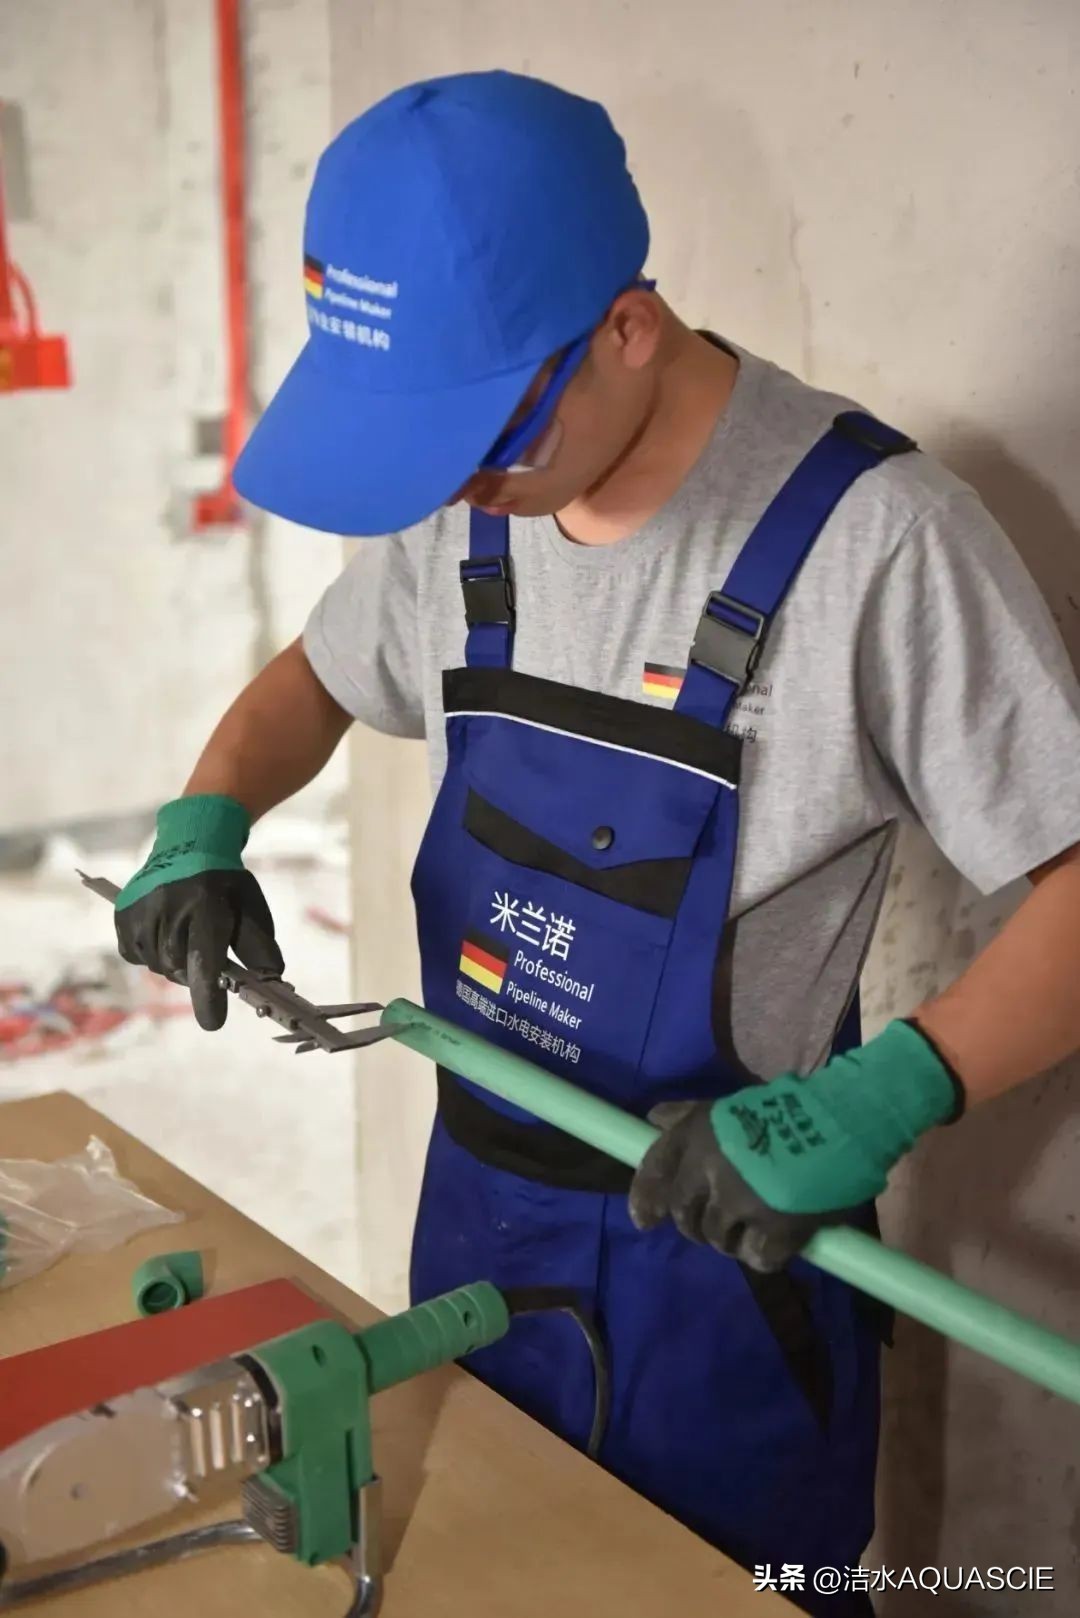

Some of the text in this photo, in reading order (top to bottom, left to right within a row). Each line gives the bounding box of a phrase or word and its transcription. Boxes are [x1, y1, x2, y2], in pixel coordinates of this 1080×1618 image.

[325, 263, 398, 299] Professional
[359, 298, 391, 321] Maker
[489, 890, 577, 961] 米兰诺
[513, 949, 595, 1003] Professional
[505, 980, 583, 1031] Pipeline Maker
